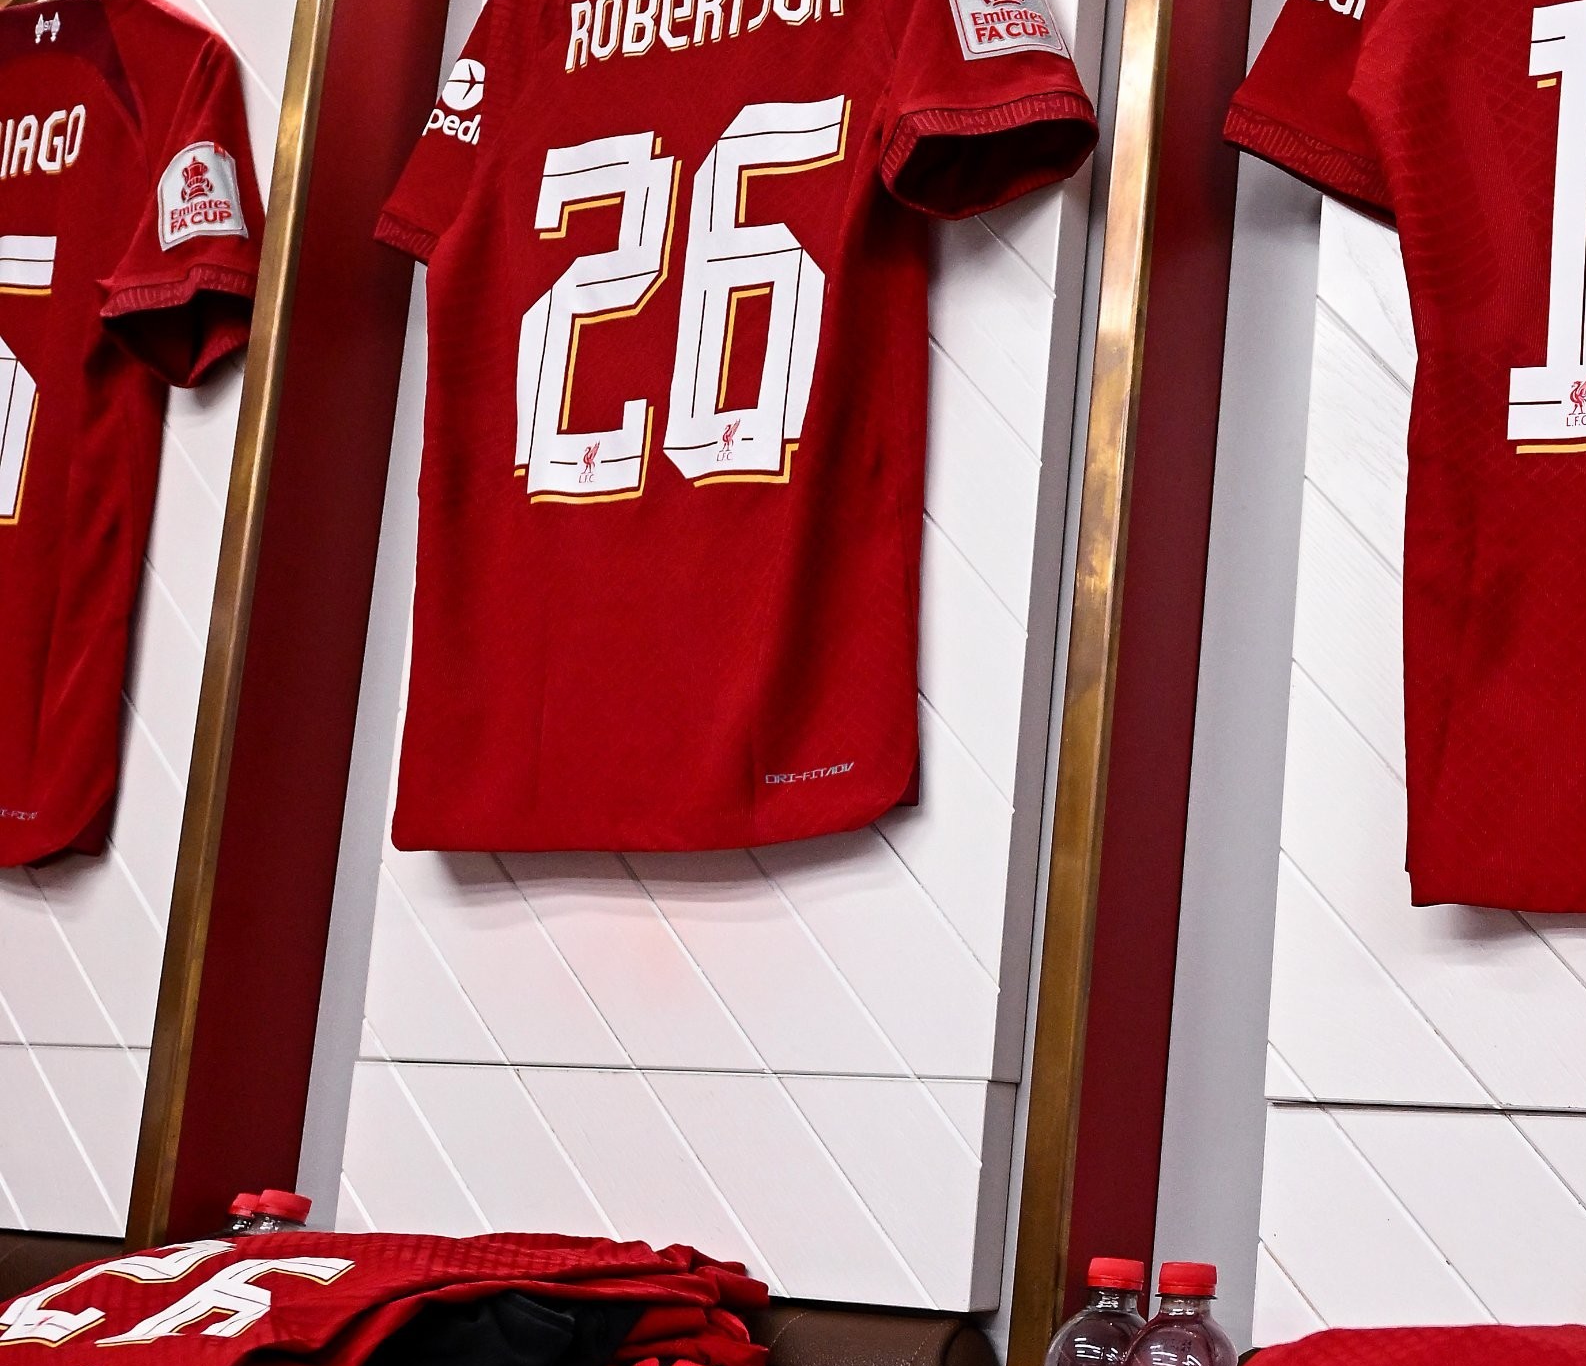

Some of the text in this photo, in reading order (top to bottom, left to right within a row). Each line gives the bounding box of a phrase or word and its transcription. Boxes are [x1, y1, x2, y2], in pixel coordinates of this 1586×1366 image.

[970, 7, 1046, 26] Emirates
[975, 22, 1050, 44] FA CUP
[170, 198, 231, 221] Emirates
[170, 210, 232, 234] FA CUP
[514, 95, 850, 501] 26
